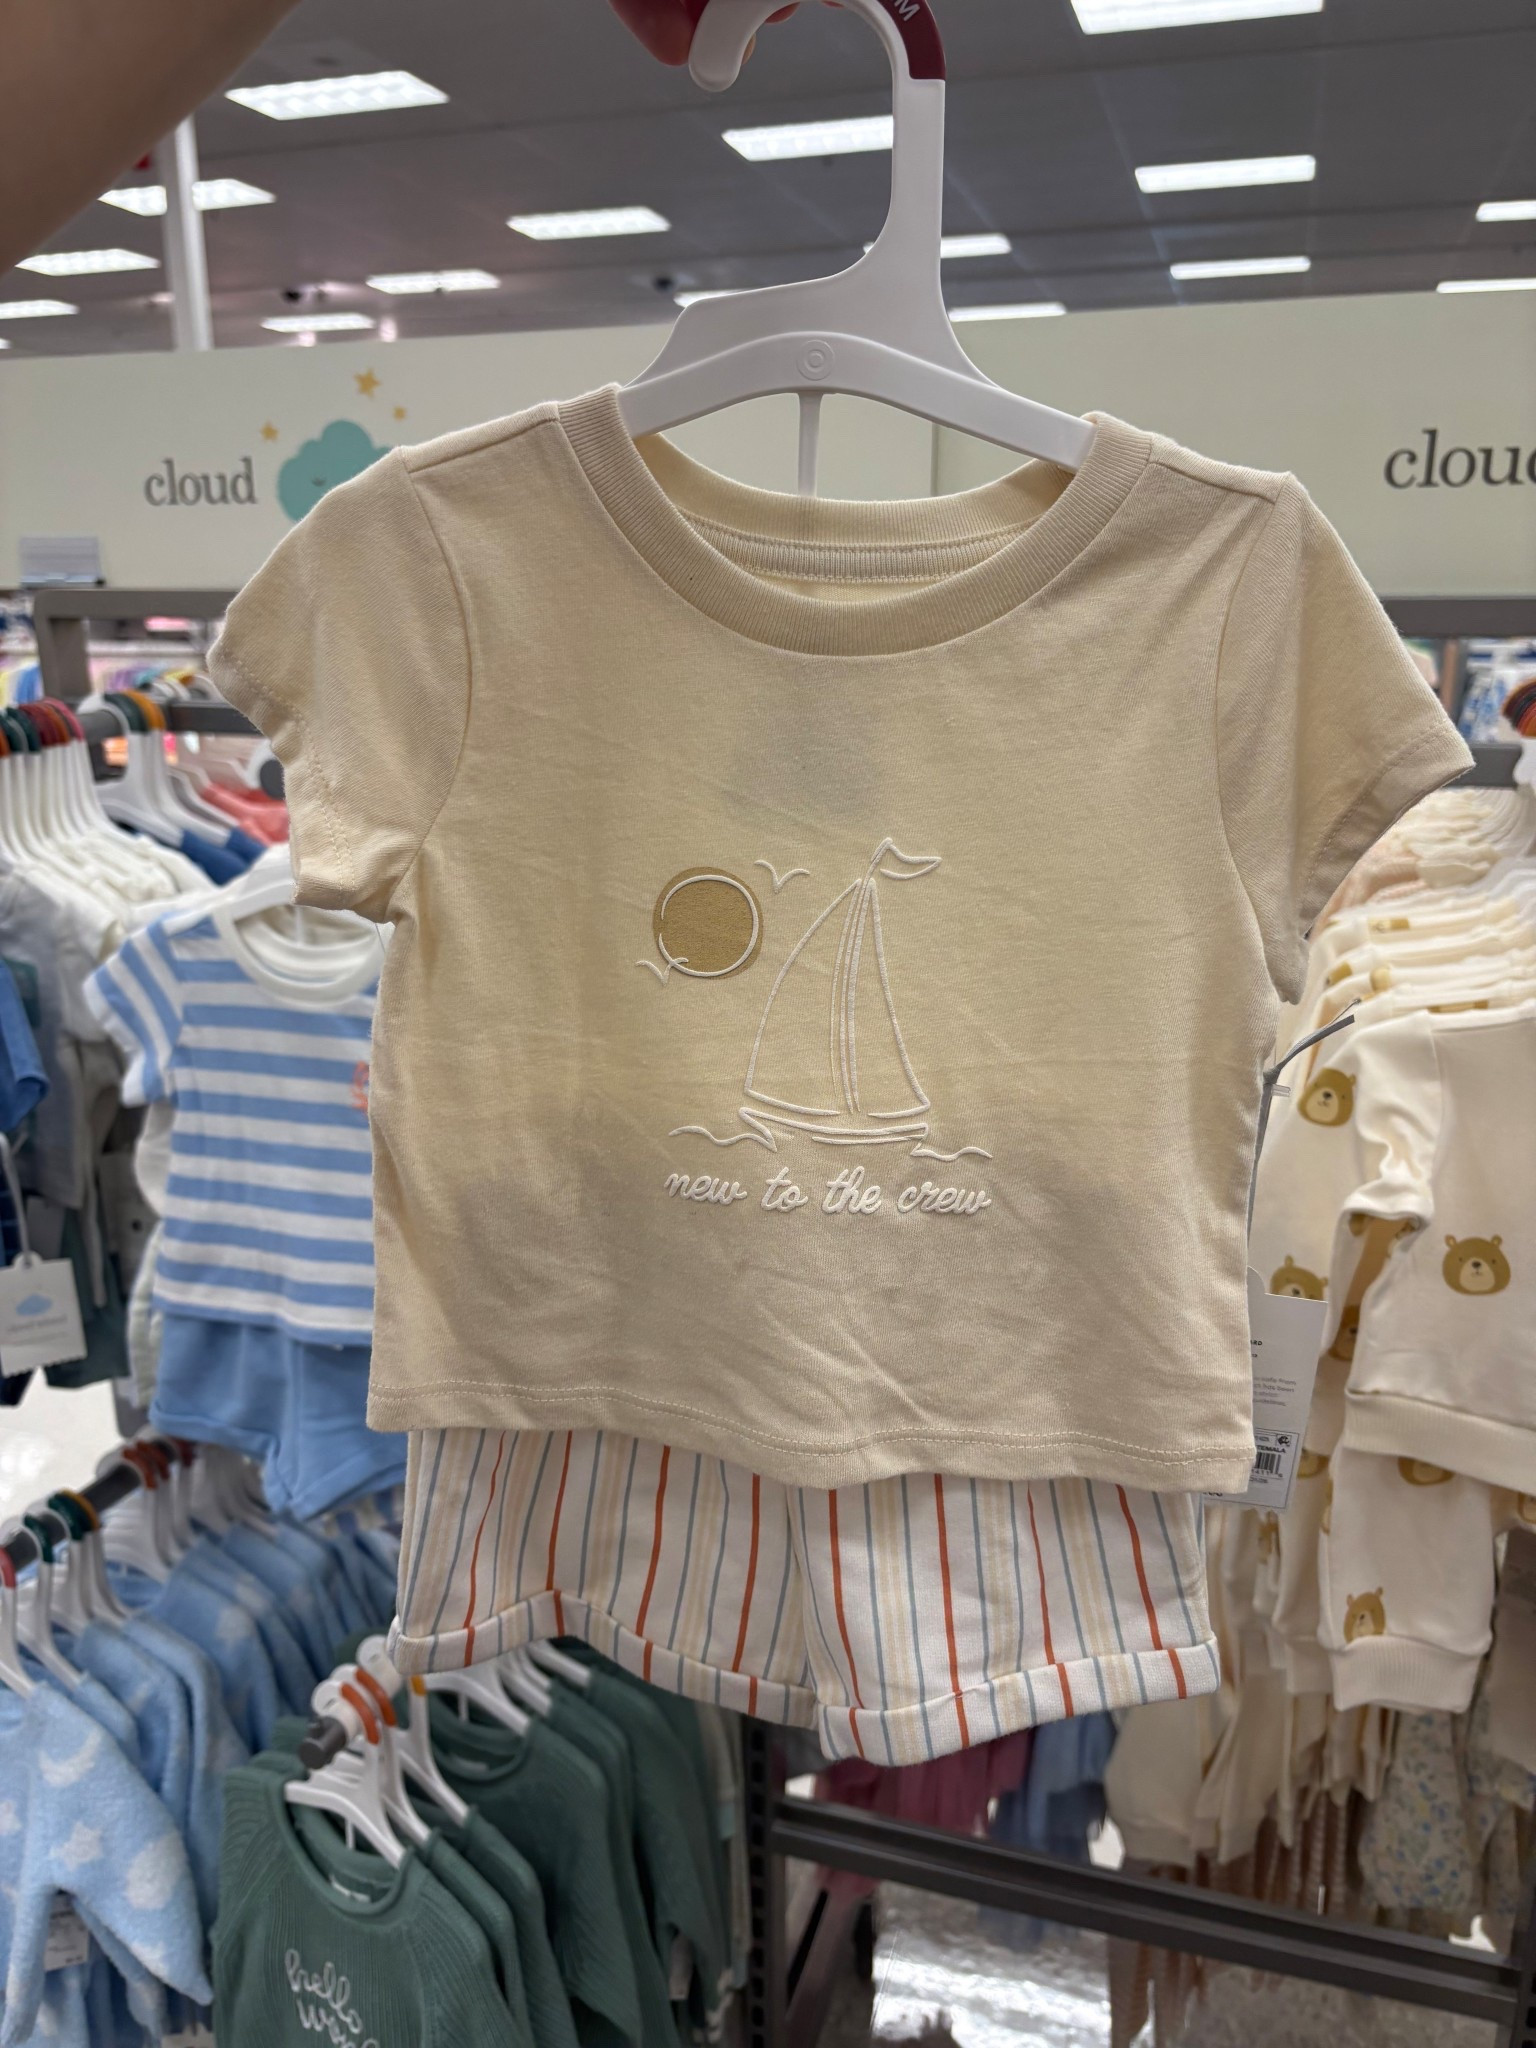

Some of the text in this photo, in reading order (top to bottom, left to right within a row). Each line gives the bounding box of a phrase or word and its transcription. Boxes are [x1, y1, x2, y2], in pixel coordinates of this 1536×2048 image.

[144, 456, 258, 506] cloud
[664, 1165, 992, 1215] new to the crew
[1256, 1444, 1286, 1454] TEMALA
[285, 1948, 364, 2035] hello
